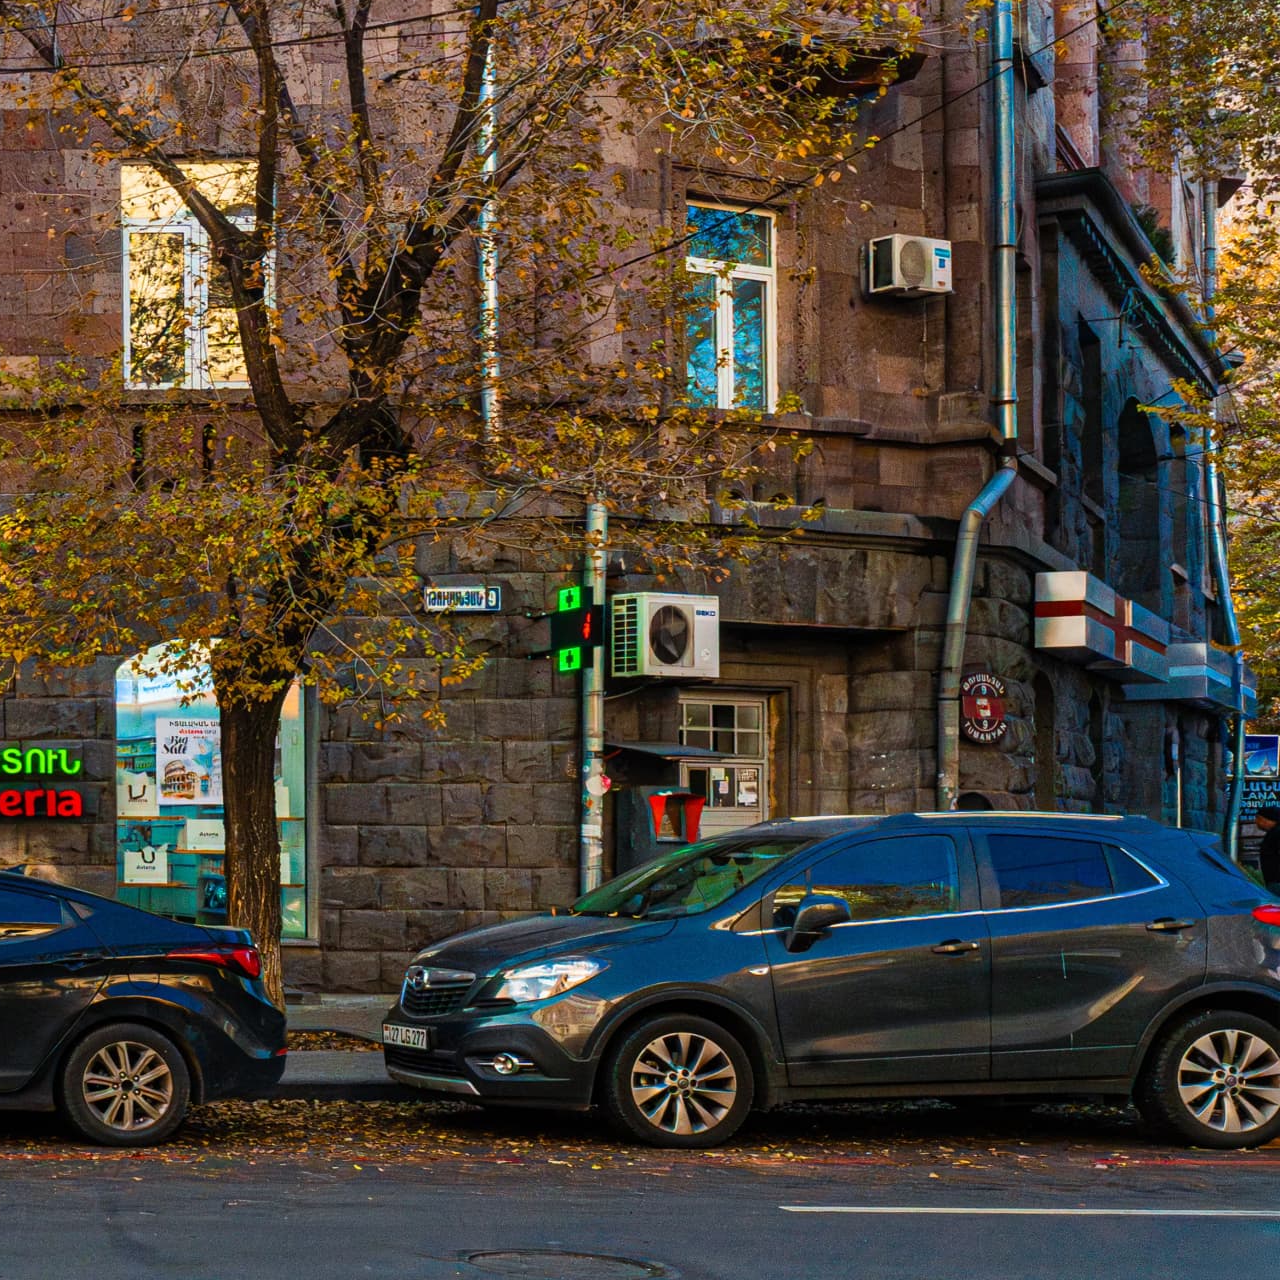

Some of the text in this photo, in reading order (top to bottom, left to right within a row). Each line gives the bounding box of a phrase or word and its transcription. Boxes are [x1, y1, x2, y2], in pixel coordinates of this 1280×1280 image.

[487, 590, 497, 607] 9
[981, 685, 987, 695] 9
[965, 721, 1007, 741] TUMANYAN
[982, 719, 989, 730] 9
[411, 1029, 425, 1047] 277
